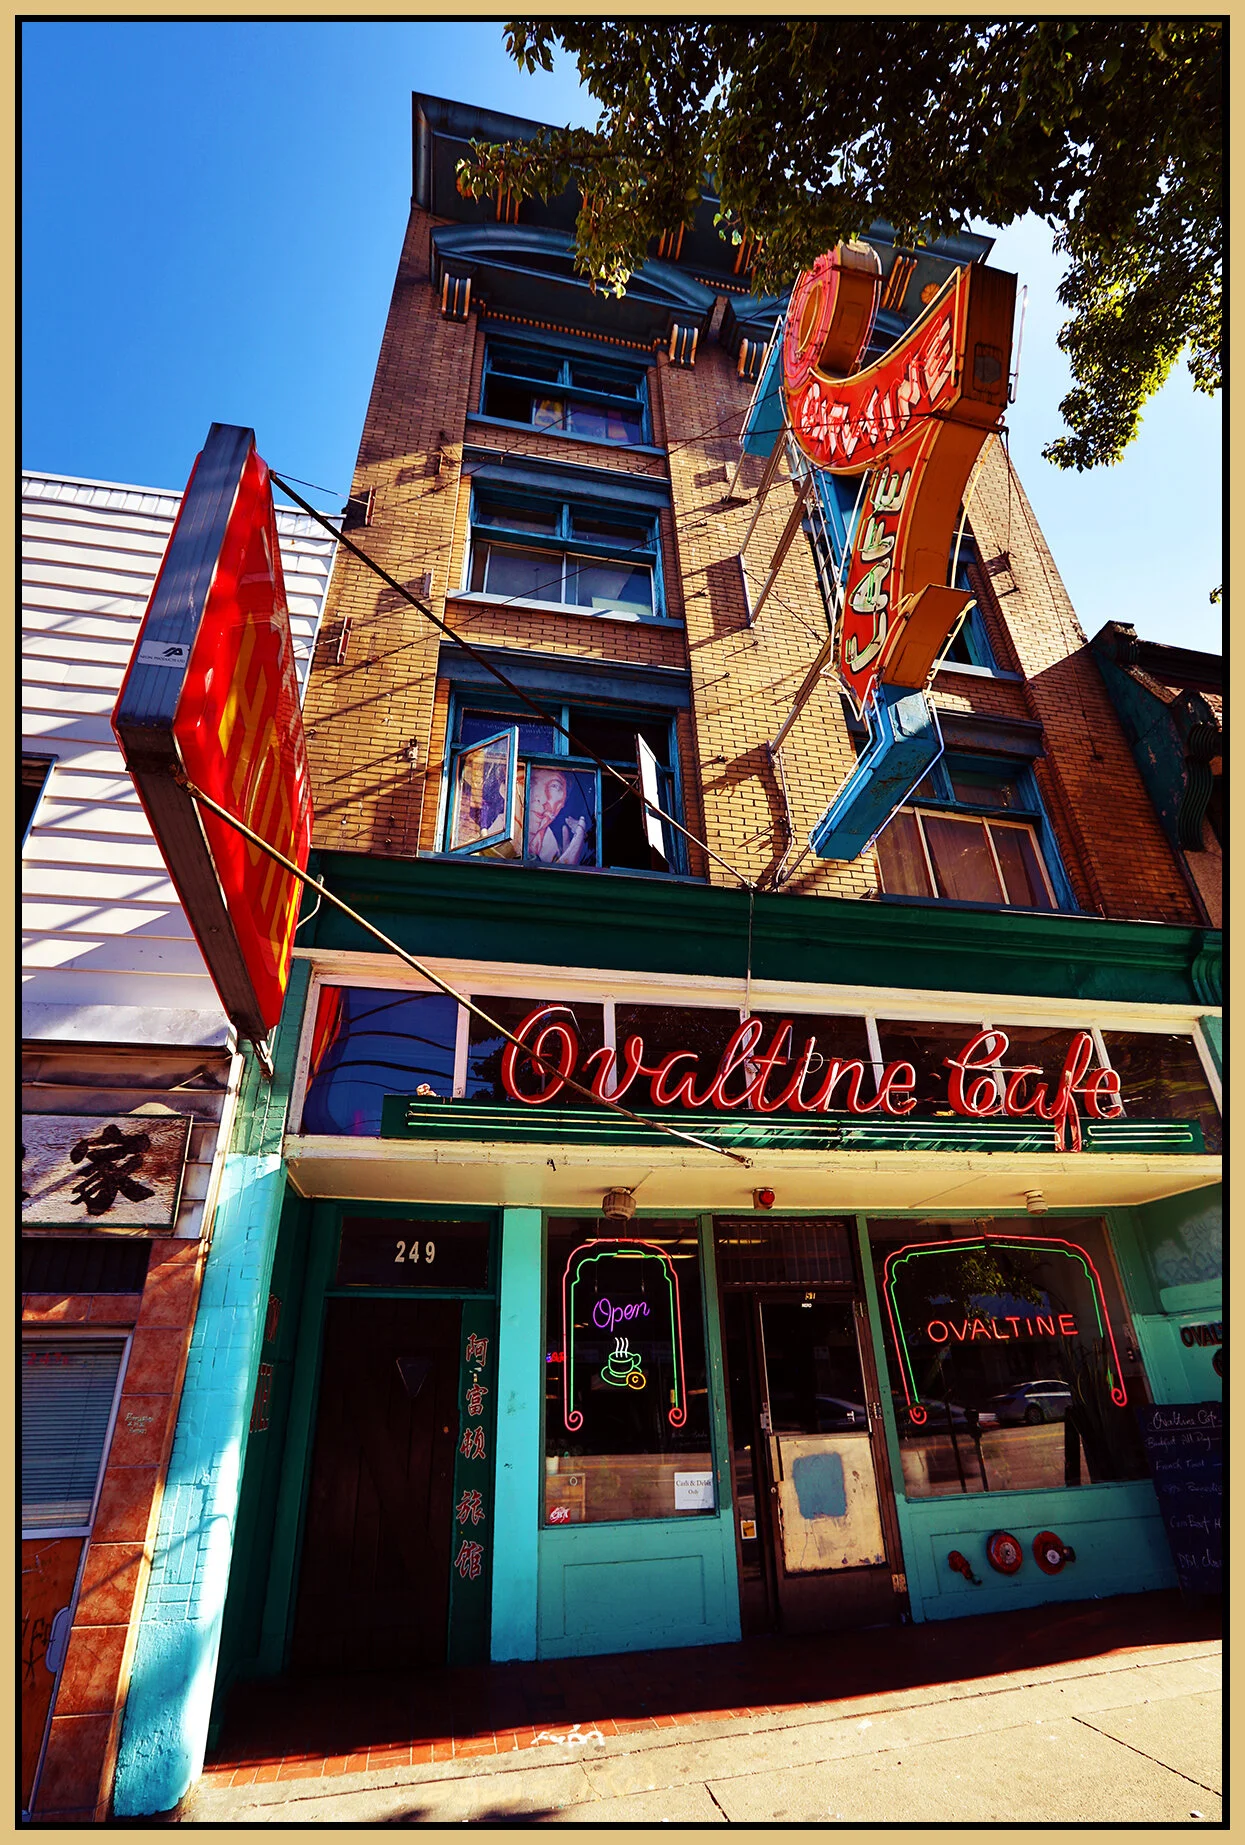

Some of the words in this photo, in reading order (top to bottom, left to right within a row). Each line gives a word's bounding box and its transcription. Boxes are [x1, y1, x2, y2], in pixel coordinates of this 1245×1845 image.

[845, 466, 912, 673] CAFE
[218, 610, 300, 996] HOTEL
[501, 1003, 917, 1114] Ovaltine
[943, 1029, 1122, 1153] Cafe
[394, 1240, 436, 1264] 249
[592, 1297, 651, 1333] Open
[927, 1313, 1079, 1343] OVALTINE
[1180, 1322, 1222, 1348] OVAL
